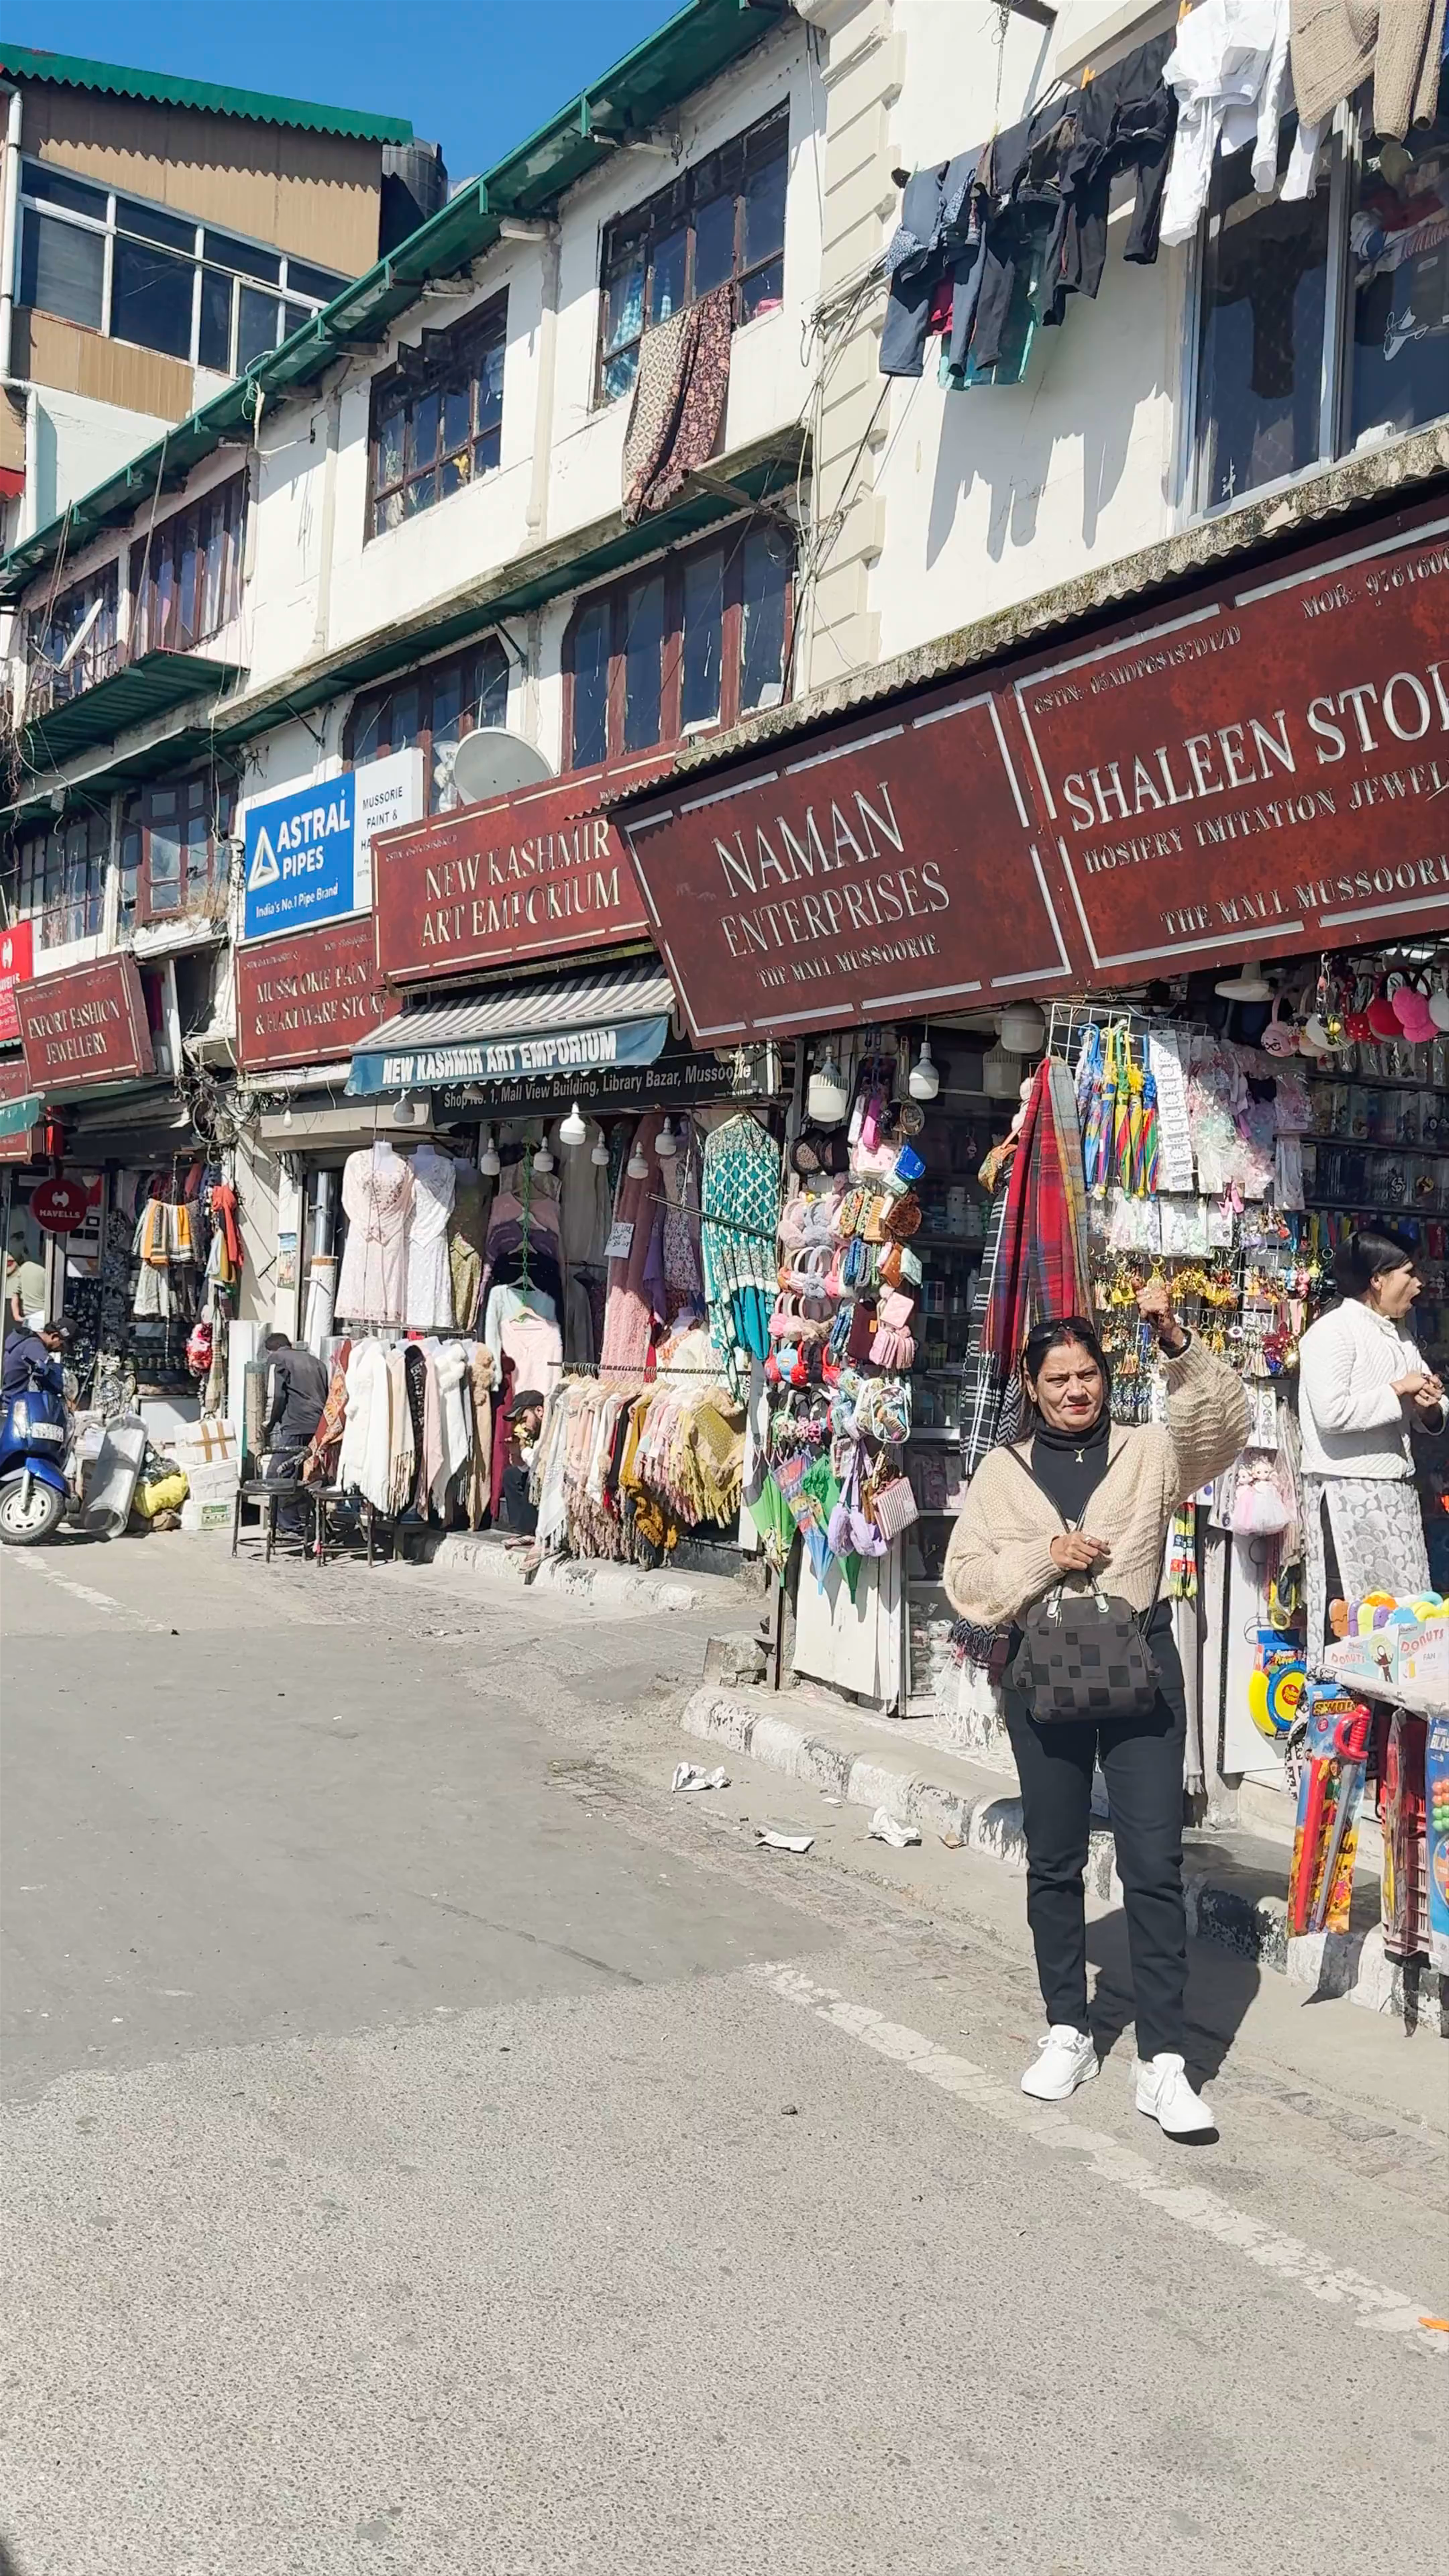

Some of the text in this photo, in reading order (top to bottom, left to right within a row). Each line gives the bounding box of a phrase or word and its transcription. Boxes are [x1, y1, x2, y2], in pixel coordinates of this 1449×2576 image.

[1063, 709, 1297, 831] SHALEEN
[363, 786, 403, 810] MUSSORIE
[367, 809, 397, 829] PAINT &
[1083, 759, 1449, 874] HOSIERY IMITATION JEWEL
[277, 794, 351, 852] ASTRAL
[711, 781, 904, 898] NAMAN
[283, 845, 324, 880] PIPES
[425, 853, 480, 901] NEW
[488, 819, 611, 886] KASHMIR
[256, 881, 338, 918] India's No.1 Pipe Brand
[421, 866, 620, 947] ART EMPORIUM
[720, 861, 950, 957] ENTERPRISES
[1160, 904, 1212, 935] THE
[1217, 889, 1289, 924] MALL
[335, 958, 374, 987] PAINT
[756, 933, 940, 988] THE MALL MUSSOORIE
[27, 1009, 68, 1040] EXPORT
[69, 997, 120, 1029] FASHION
[255, 1013, 265, 1035] &
[45, 1032, 108, 1065] JEWELLERY
[381, 1030, 617, 1084] NEW KASHMIR ART EMPORIUM
[444, 1092, 467, 1110] Shop
[490, 1089, 498, 1105] 1,
[501, 1084, 522, 1102] Mall
[525, 1083, 551, 1100] View
[553, 1079, 600, 1097] Building,
[603, 1075, 642, 1092] Library
[646, 1070, 681, 1087] Bazar,
[685, 1064, 751, 1084] Mussooe
[40, 1209, 80, 1219] HAVELLS
[1400, 1627, 1444, 1652] DONUTS
[1423, 1652, 1436, 1661] FAN
